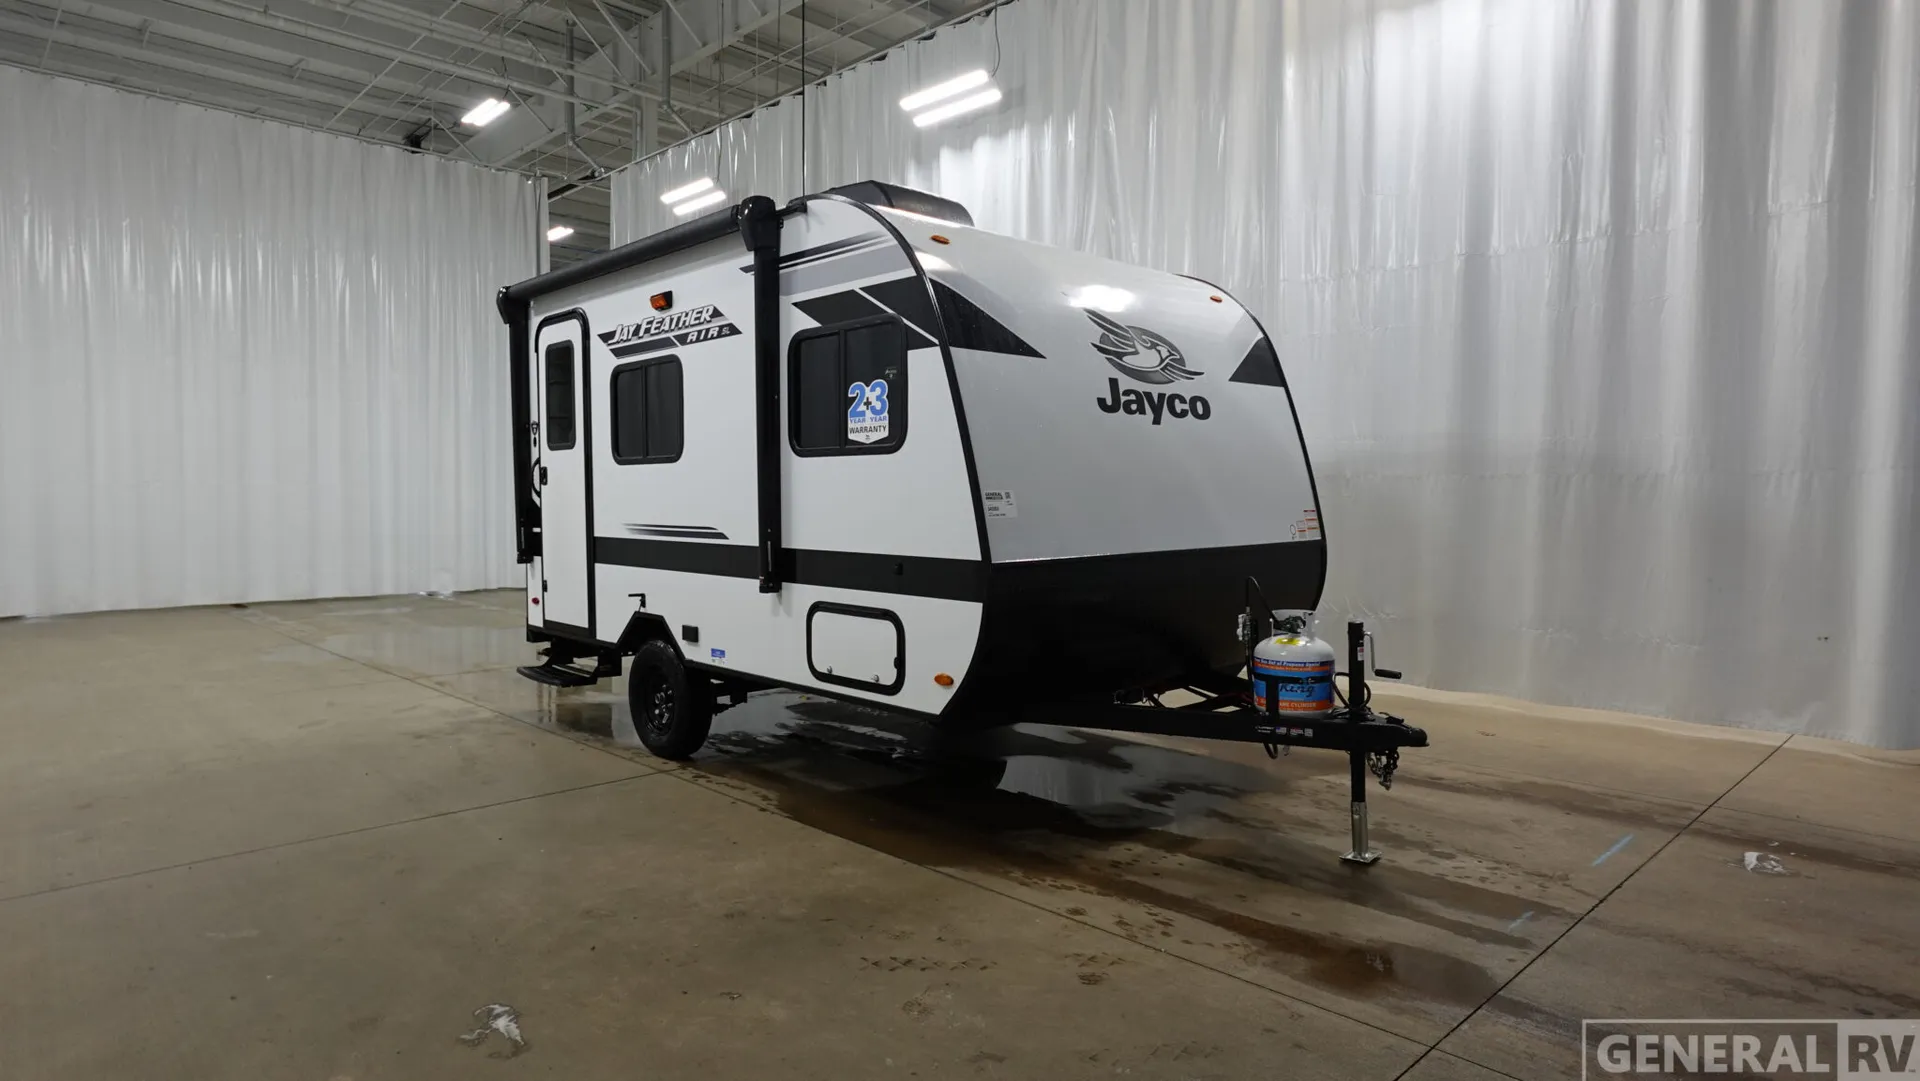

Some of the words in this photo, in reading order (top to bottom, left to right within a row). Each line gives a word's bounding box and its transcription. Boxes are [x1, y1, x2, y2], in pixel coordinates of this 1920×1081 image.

[607, 323, 638, 345] JAY
[639, 304, 714, 337] FEATHER
[687, 326, 719, 343] AIR
[1096, 377, 1211, 425] Jayco
[849, 425, 887, 434] WARRANTY
